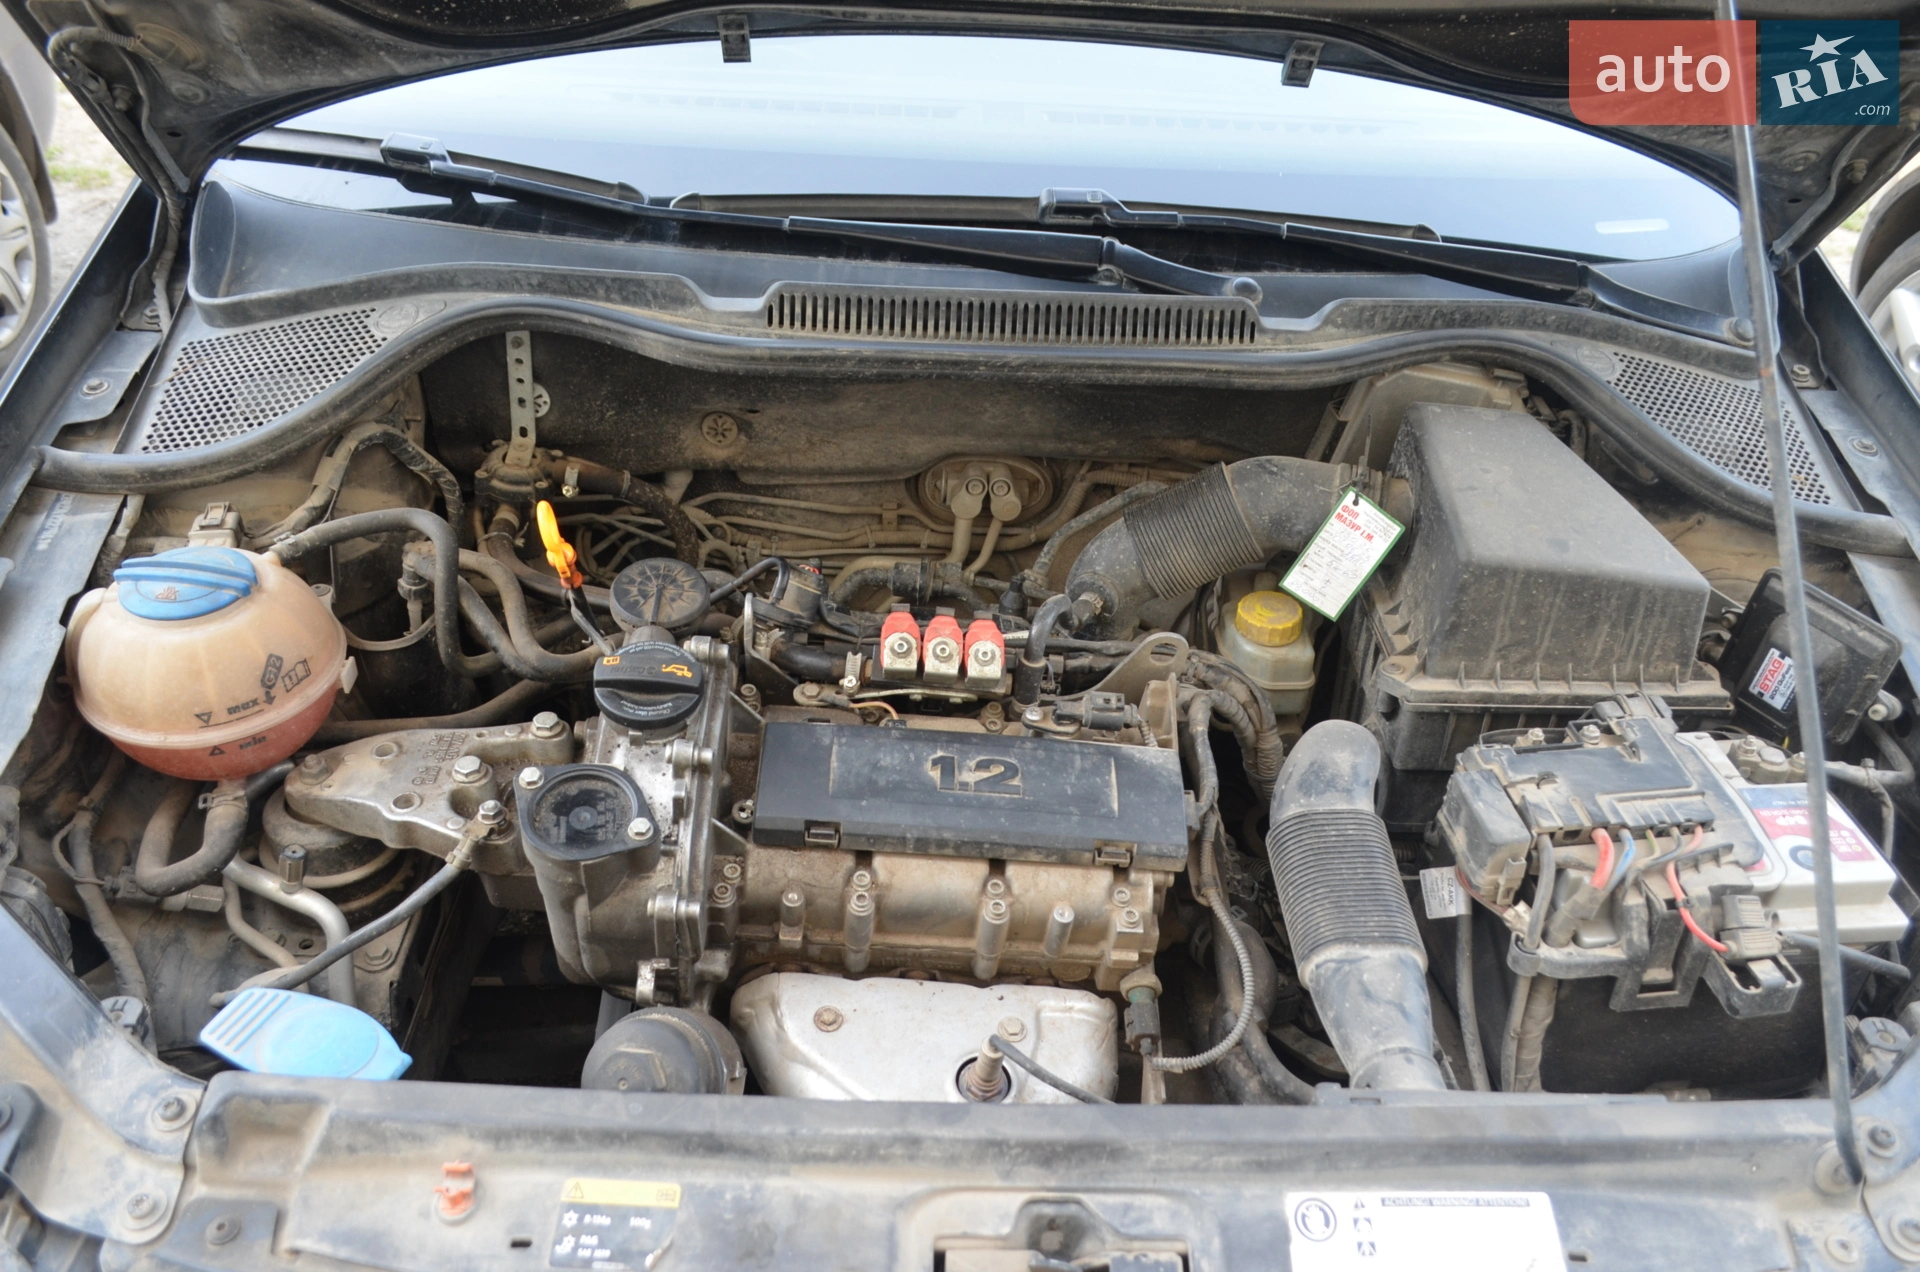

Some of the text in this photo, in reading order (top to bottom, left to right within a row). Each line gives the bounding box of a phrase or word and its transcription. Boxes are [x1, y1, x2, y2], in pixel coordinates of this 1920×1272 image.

[1340, 504, 1360, 520] ФОП
[1334, 512, 1362, 532] МАЗУР
[264, 657, 281, 686] G12
[1760, 658, 1783, 692] STAG
[1769, 686, 1780, 700] 200
[226, 698, 260, 715] max
[238, 736, 267, 750] min
[928, 754, 1023, 797] 1.2
